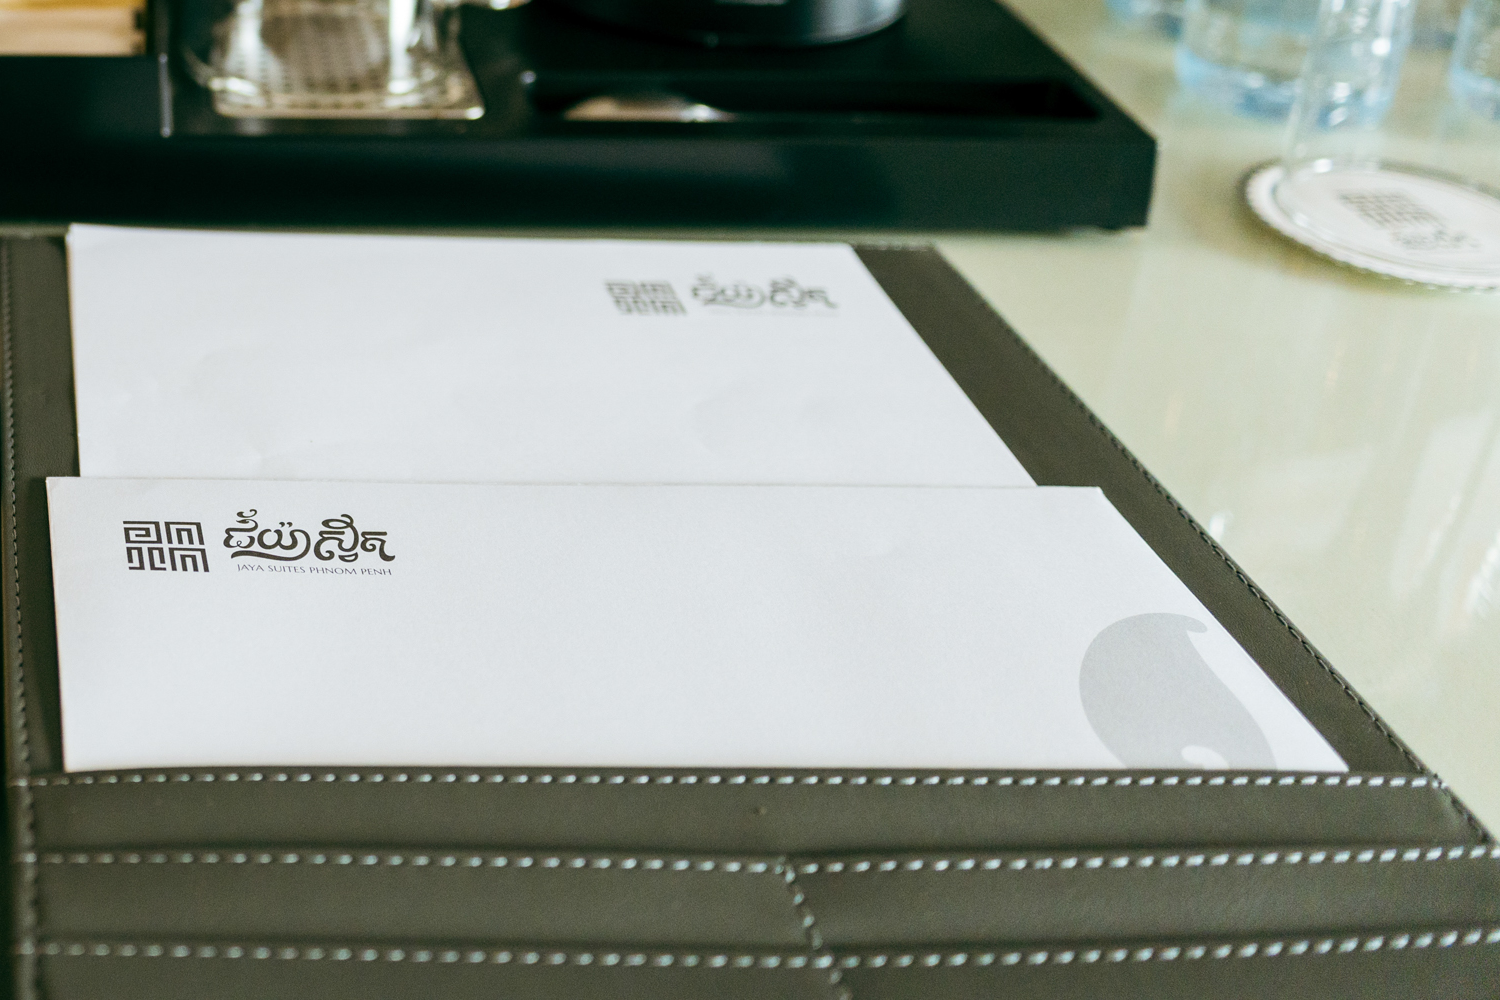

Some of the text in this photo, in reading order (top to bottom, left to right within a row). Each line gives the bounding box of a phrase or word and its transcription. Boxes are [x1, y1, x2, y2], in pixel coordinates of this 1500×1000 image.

[237, 563, 392, 576] JAYA SUITES PHNOM PENH
